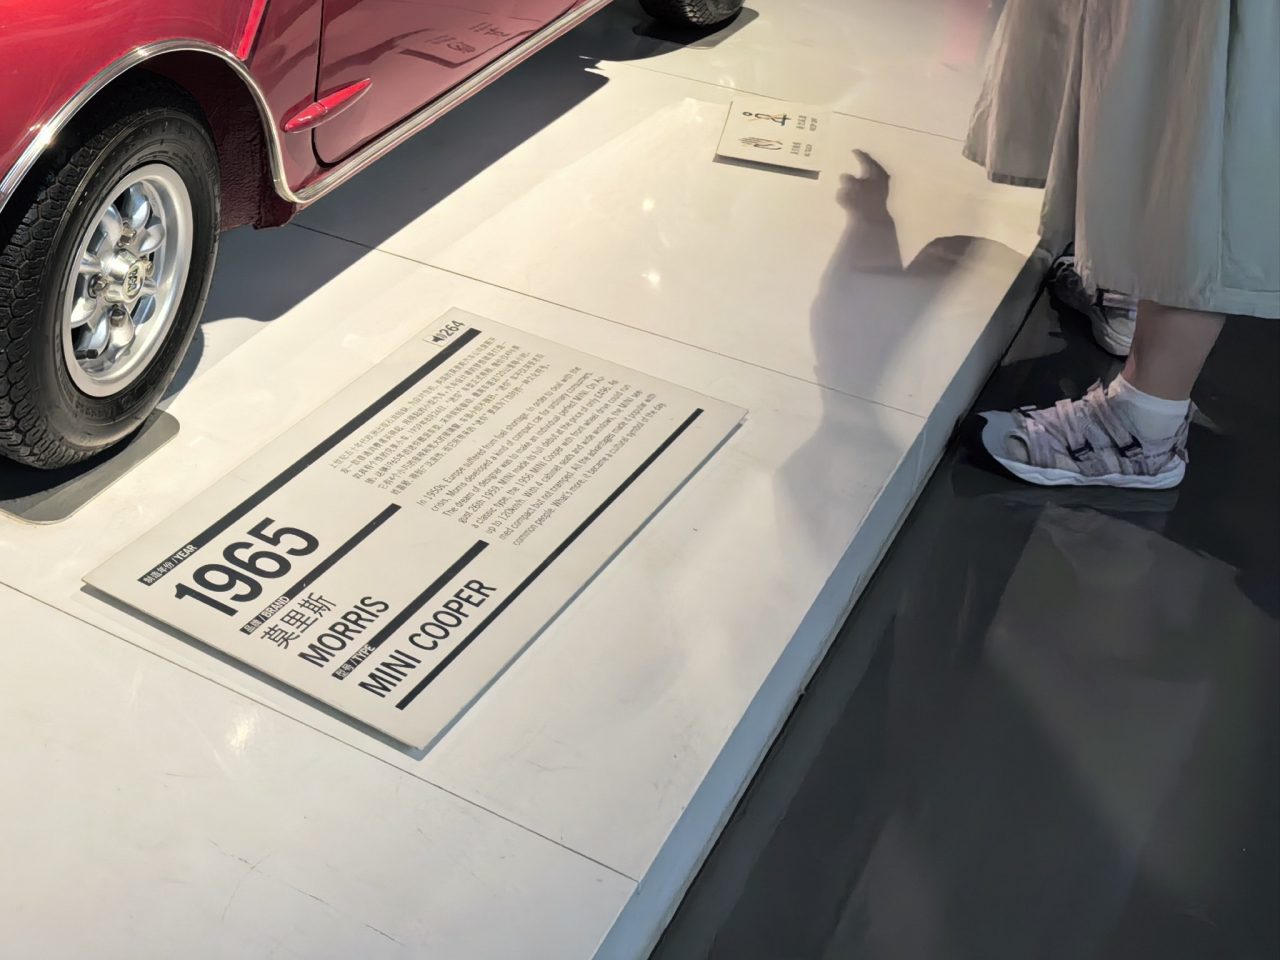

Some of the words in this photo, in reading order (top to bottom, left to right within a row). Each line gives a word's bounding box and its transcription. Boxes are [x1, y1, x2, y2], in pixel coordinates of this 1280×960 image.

[439, 319, 465, 337] 264
[175, 518, 318, 616] 1965
[261, 593, 336, 649] 莫里斯
[299, 597, 388, 667] MORRIS
[359, 650, 421, 697] MINI
[409, 580, 496, 650] COOPER
